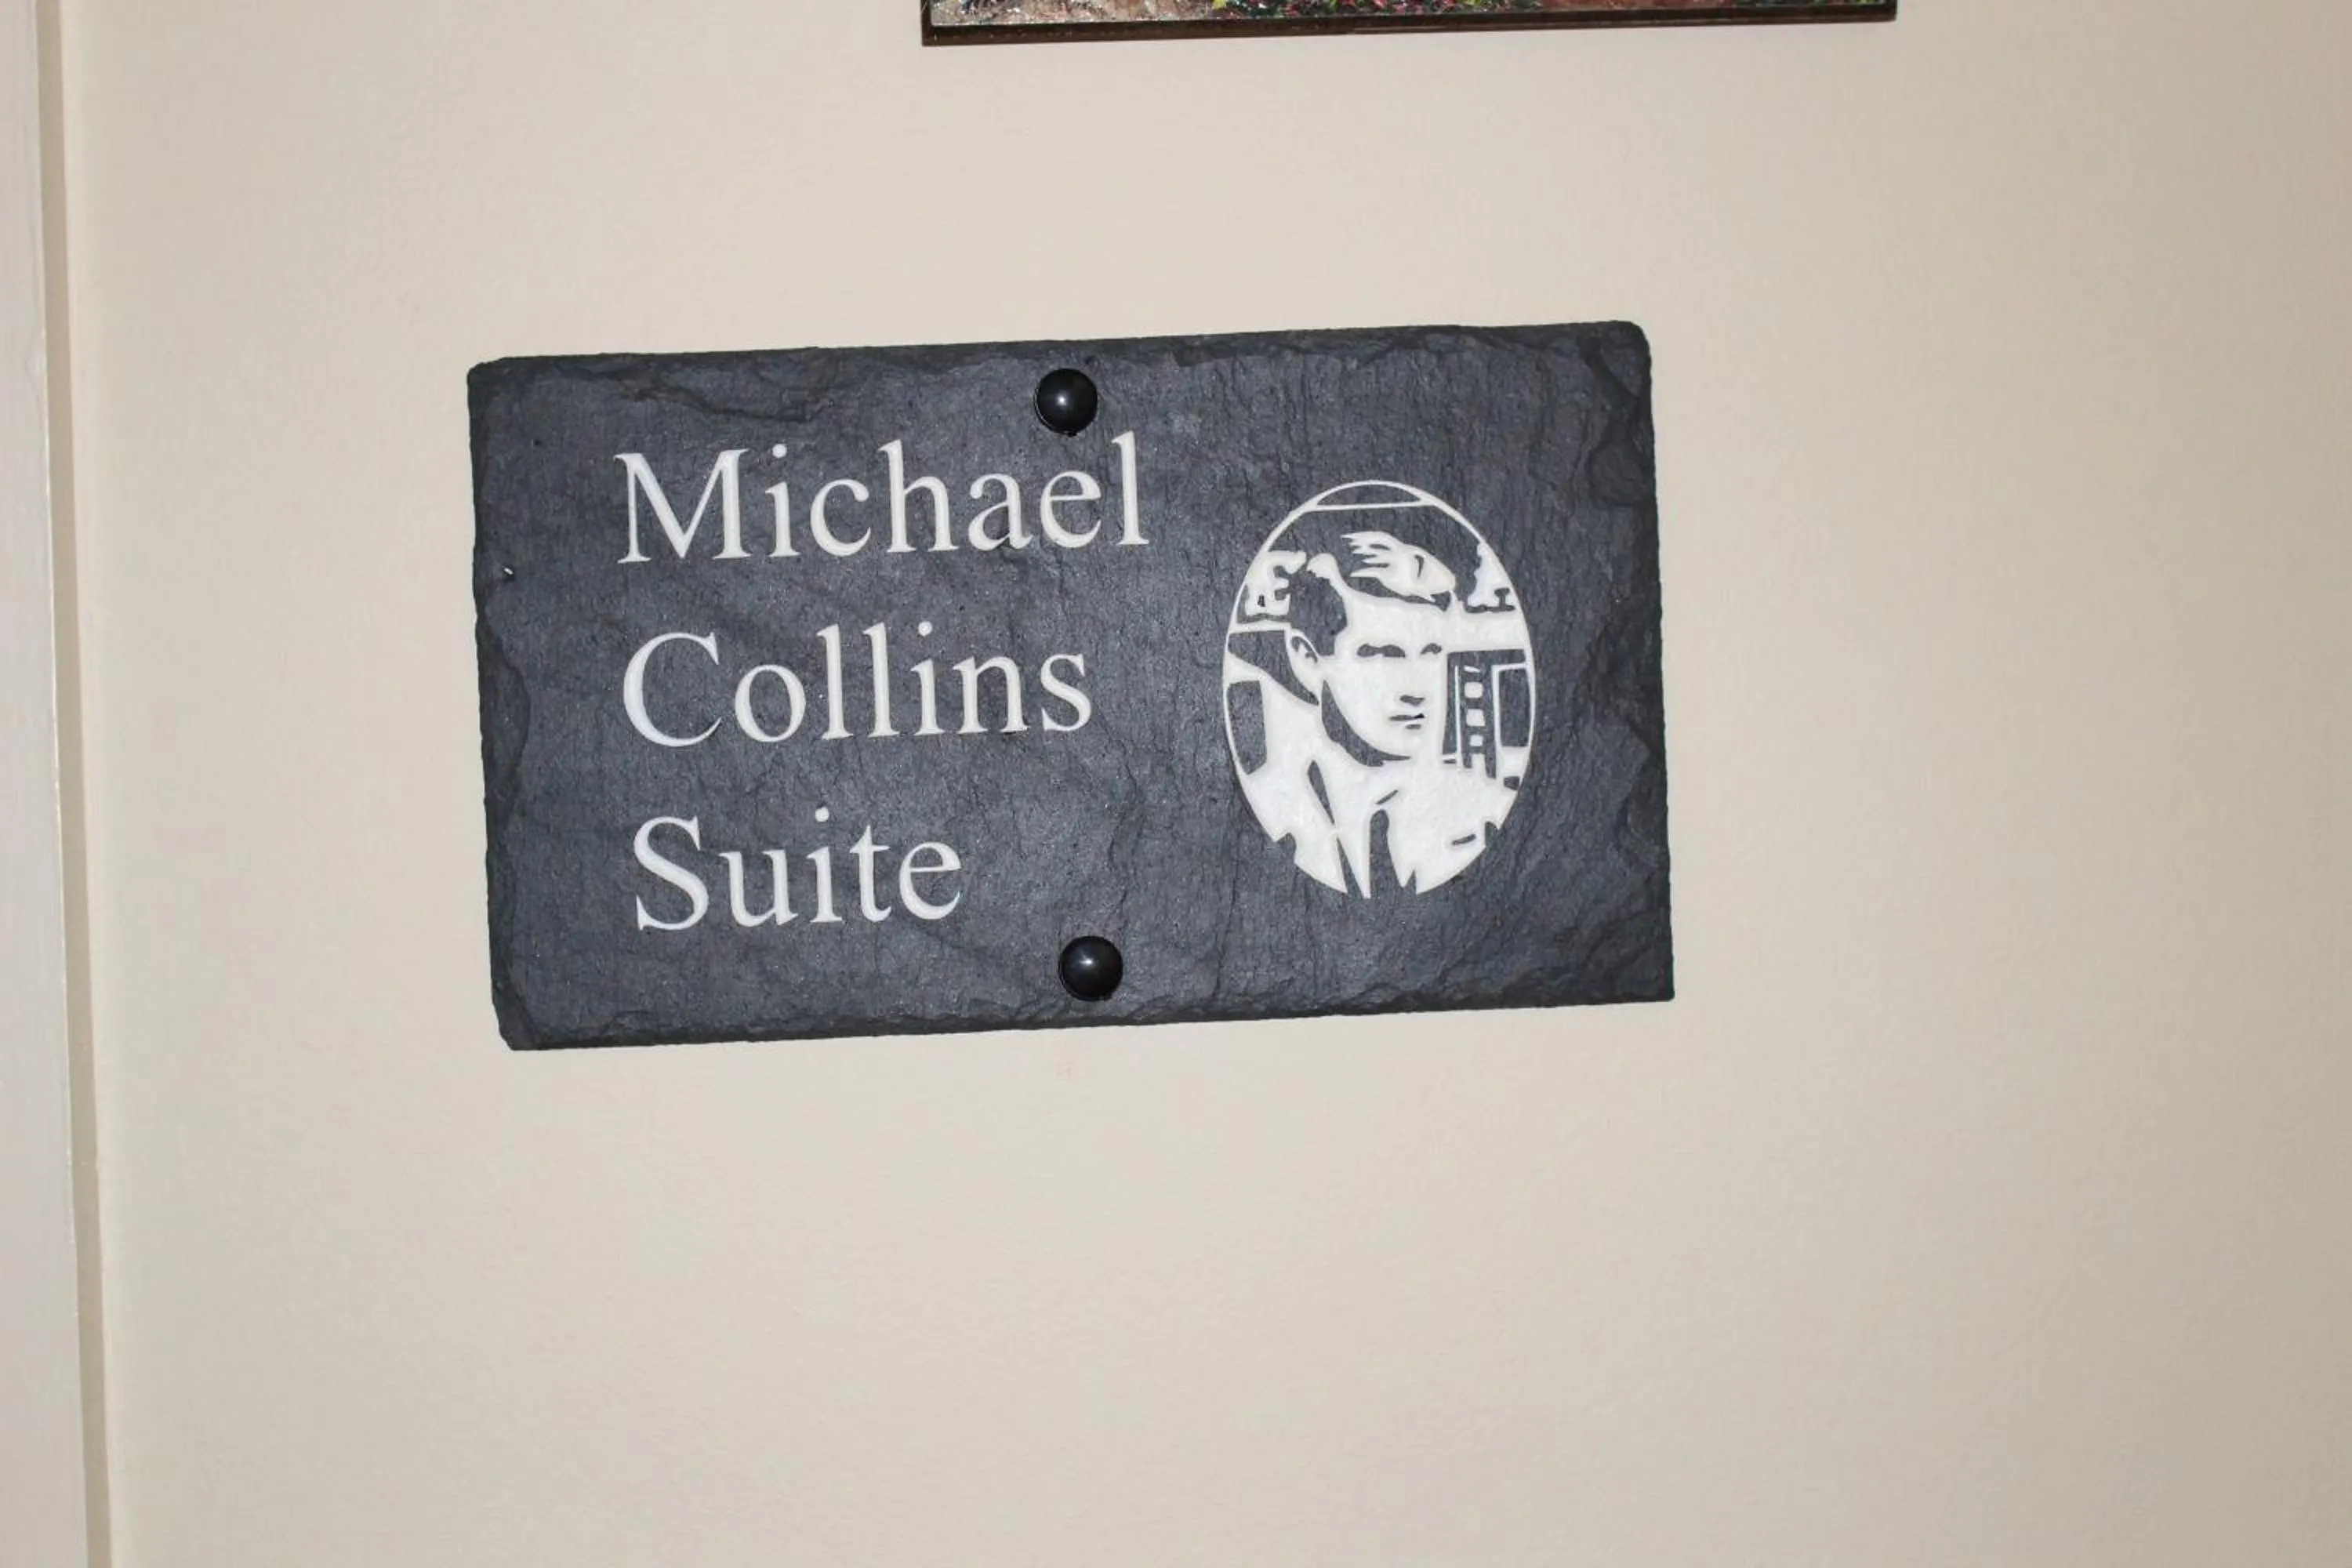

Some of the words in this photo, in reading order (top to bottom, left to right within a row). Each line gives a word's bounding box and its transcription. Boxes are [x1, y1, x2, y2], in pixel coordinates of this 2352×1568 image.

[613, 430, 1151, 564] Michael
[622, 620, 1093, 748] Collins
[632, 806, 963, 931] Suite
